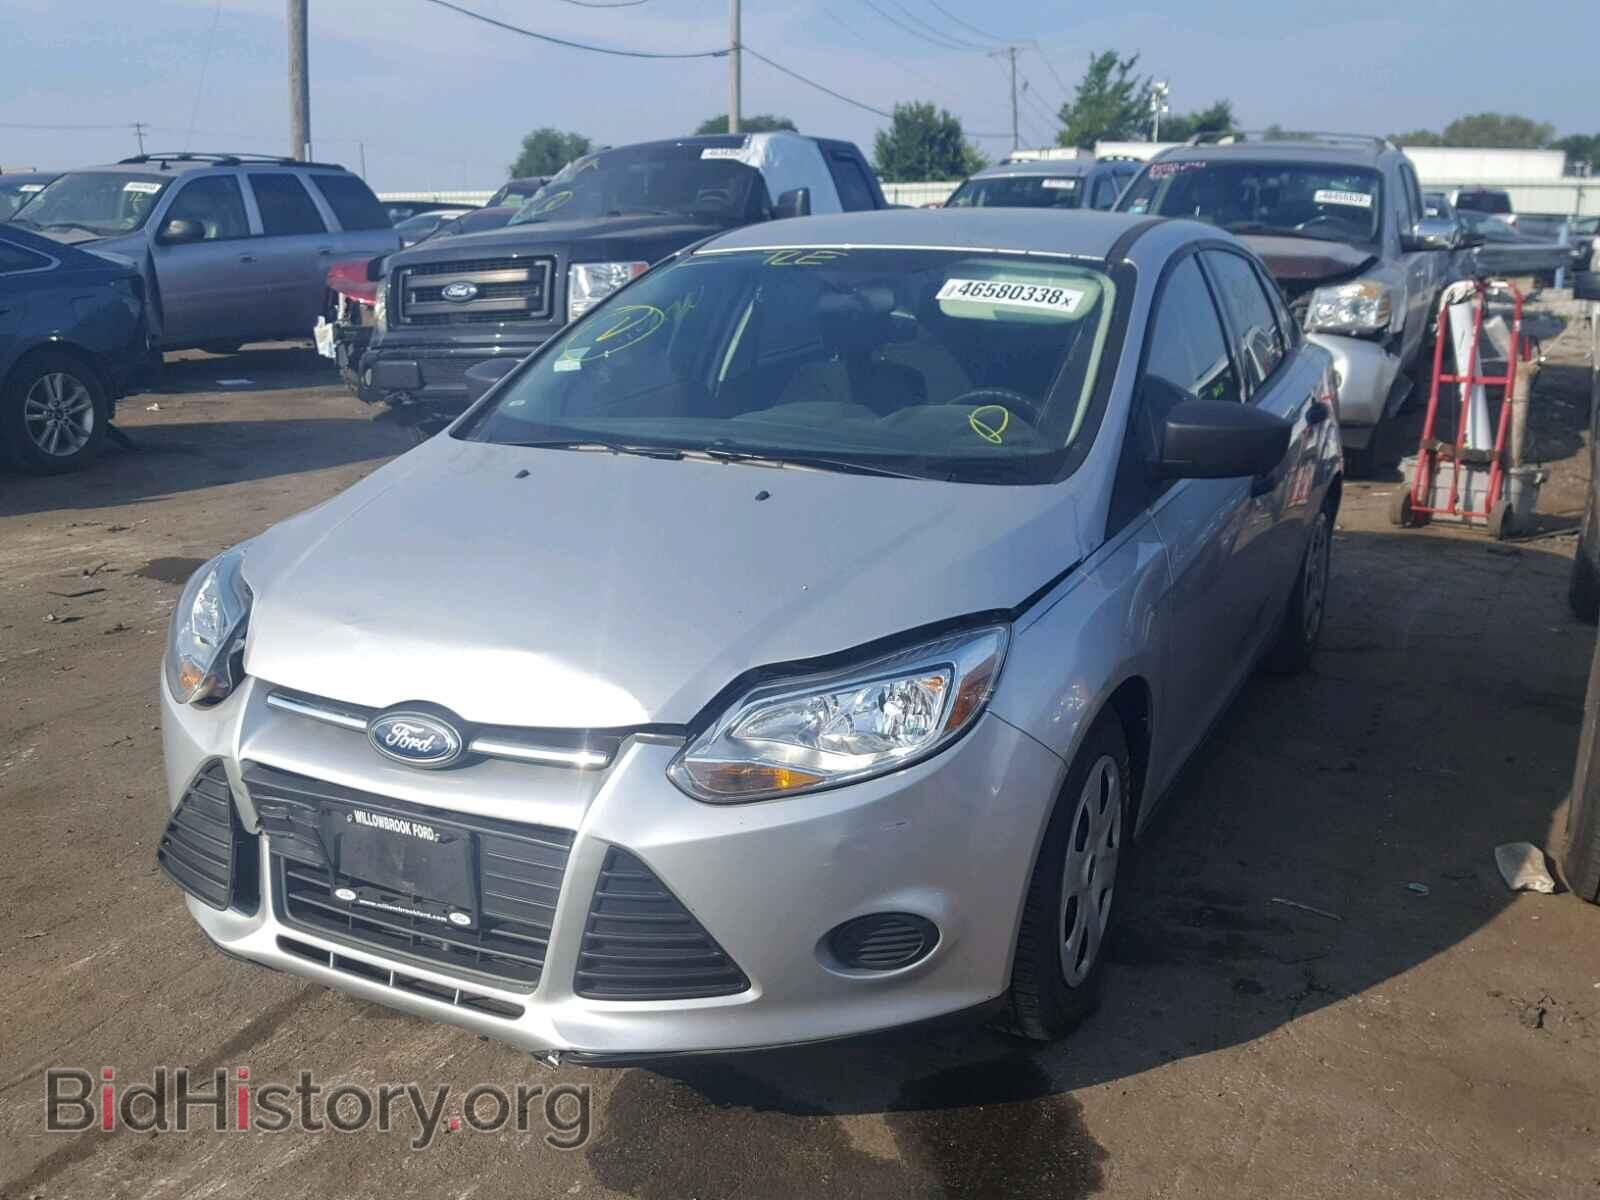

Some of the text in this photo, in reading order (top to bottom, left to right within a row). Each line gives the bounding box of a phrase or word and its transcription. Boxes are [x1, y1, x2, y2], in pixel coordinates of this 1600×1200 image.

[385, 723, 436, 752] Ford
[354, 809, 434, 841] WILLOWBROOK FORD
